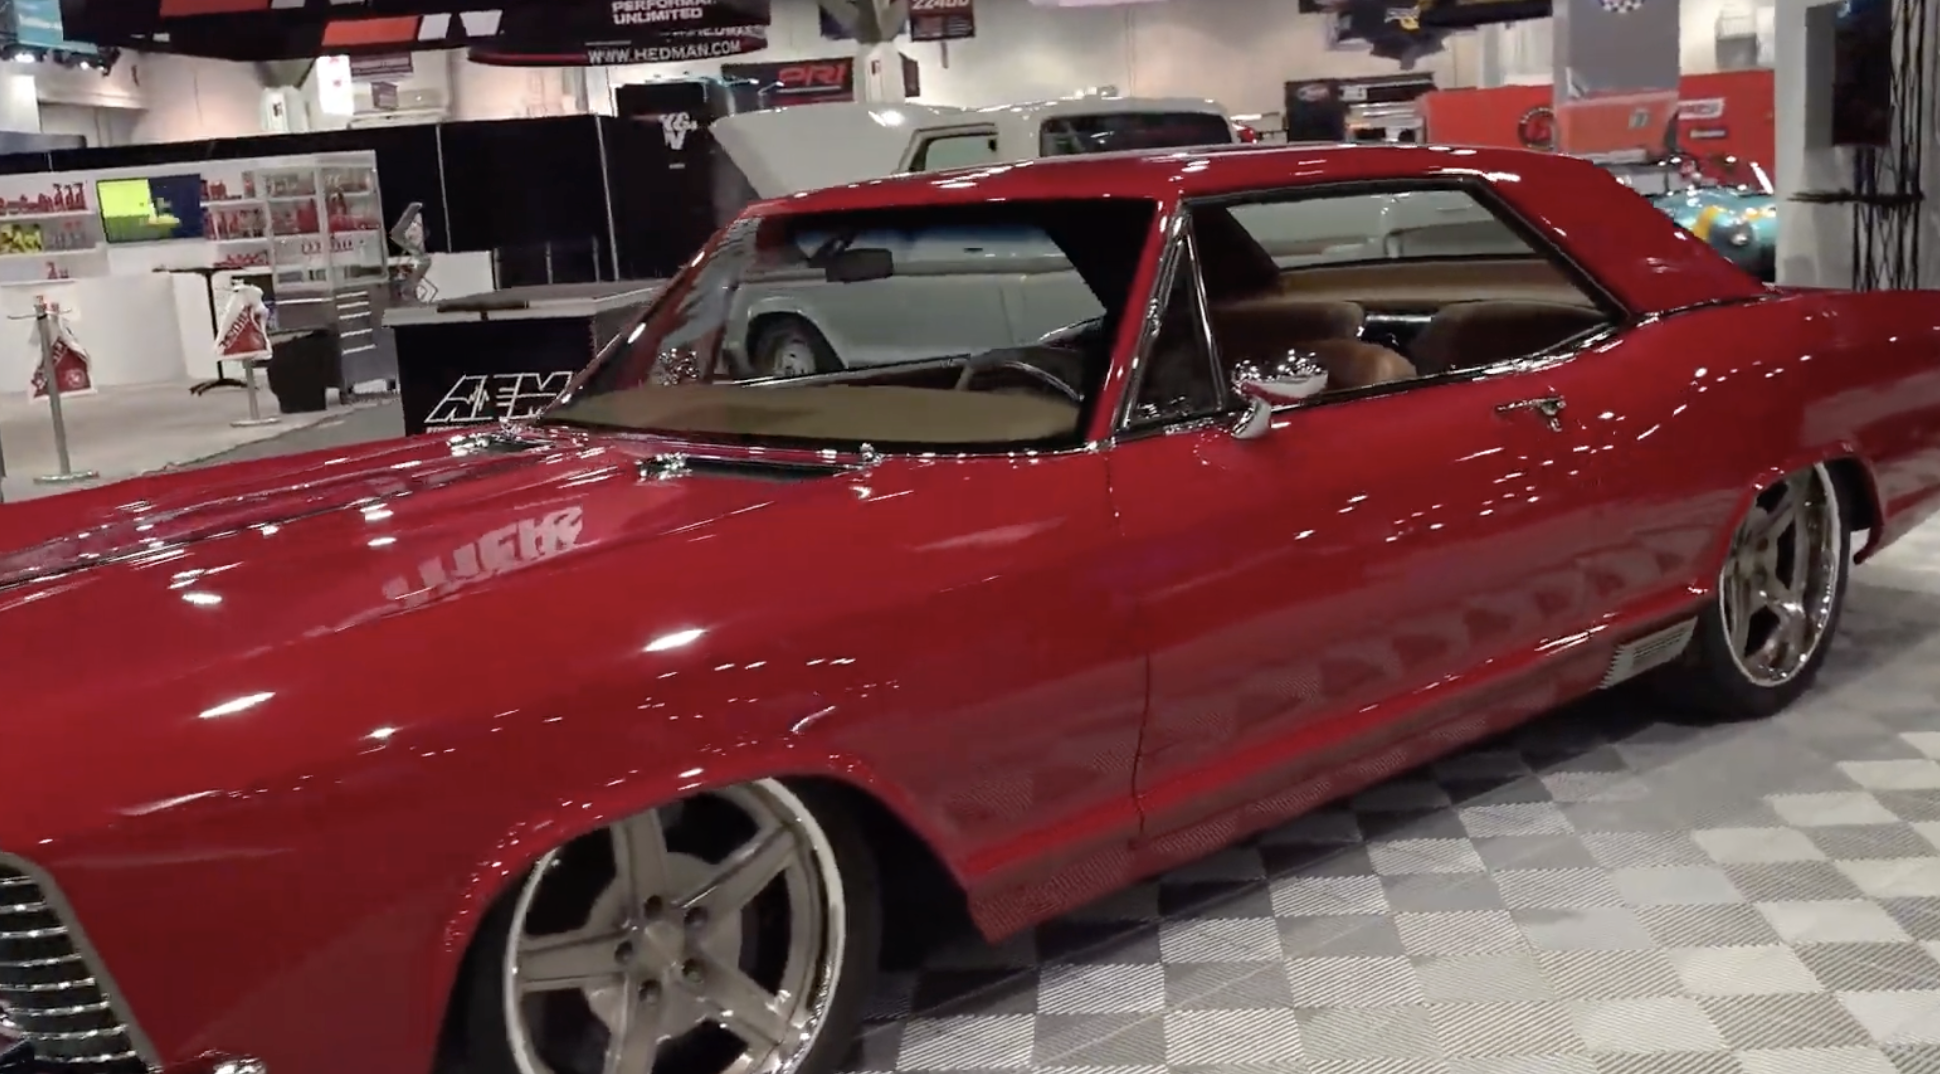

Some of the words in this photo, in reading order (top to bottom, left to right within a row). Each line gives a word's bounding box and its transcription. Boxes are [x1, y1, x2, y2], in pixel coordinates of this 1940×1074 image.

[613, 8, 703, 25] UNLIMITED
[588, 40, 741, 64] WWW.HEDMAN.COM
[779, 65, 846, 86] PRI
[424, 371, 573, 423] AEM
